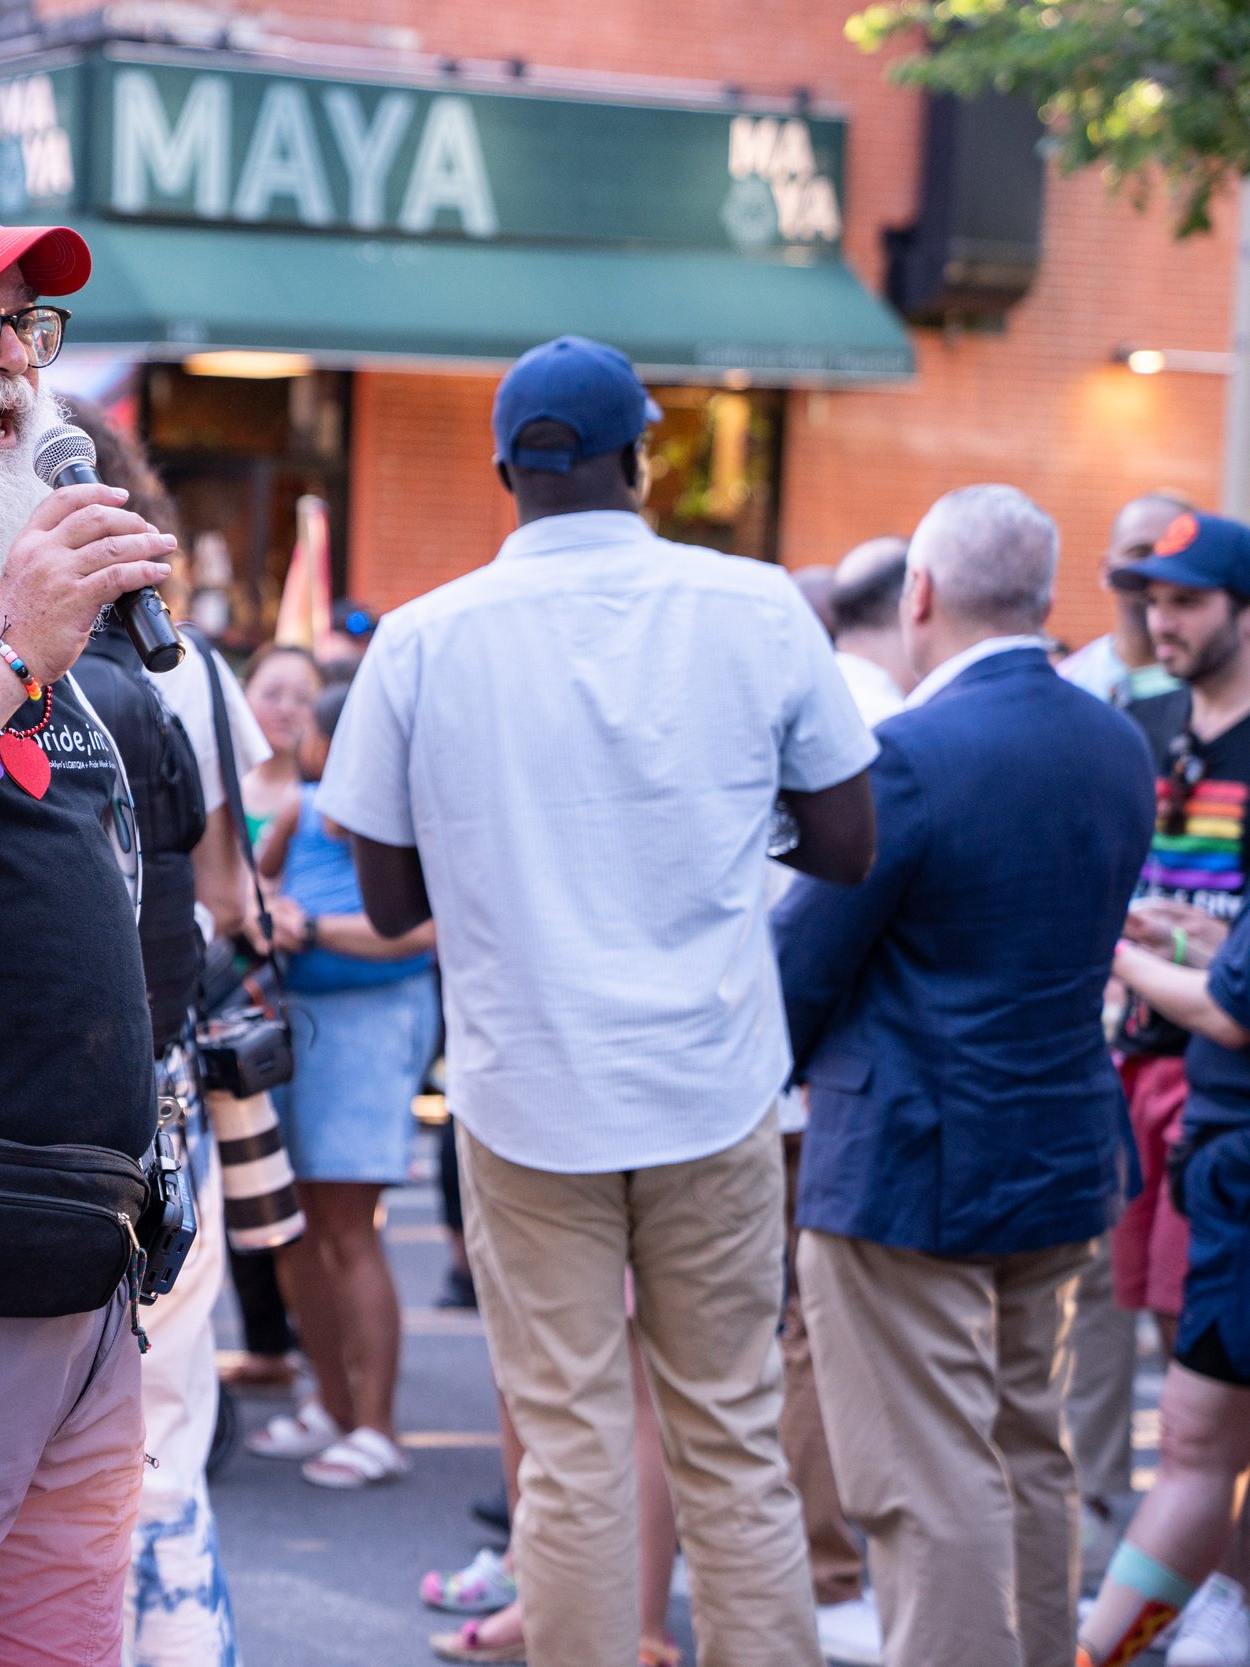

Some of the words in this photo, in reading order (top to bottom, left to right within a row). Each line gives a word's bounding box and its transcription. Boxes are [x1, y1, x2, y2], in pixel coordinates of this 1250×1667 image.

[112, 69, 499, 239] MAYA
[729, 115, 817, 181] MA
[771, 175, 841, 241] YA
